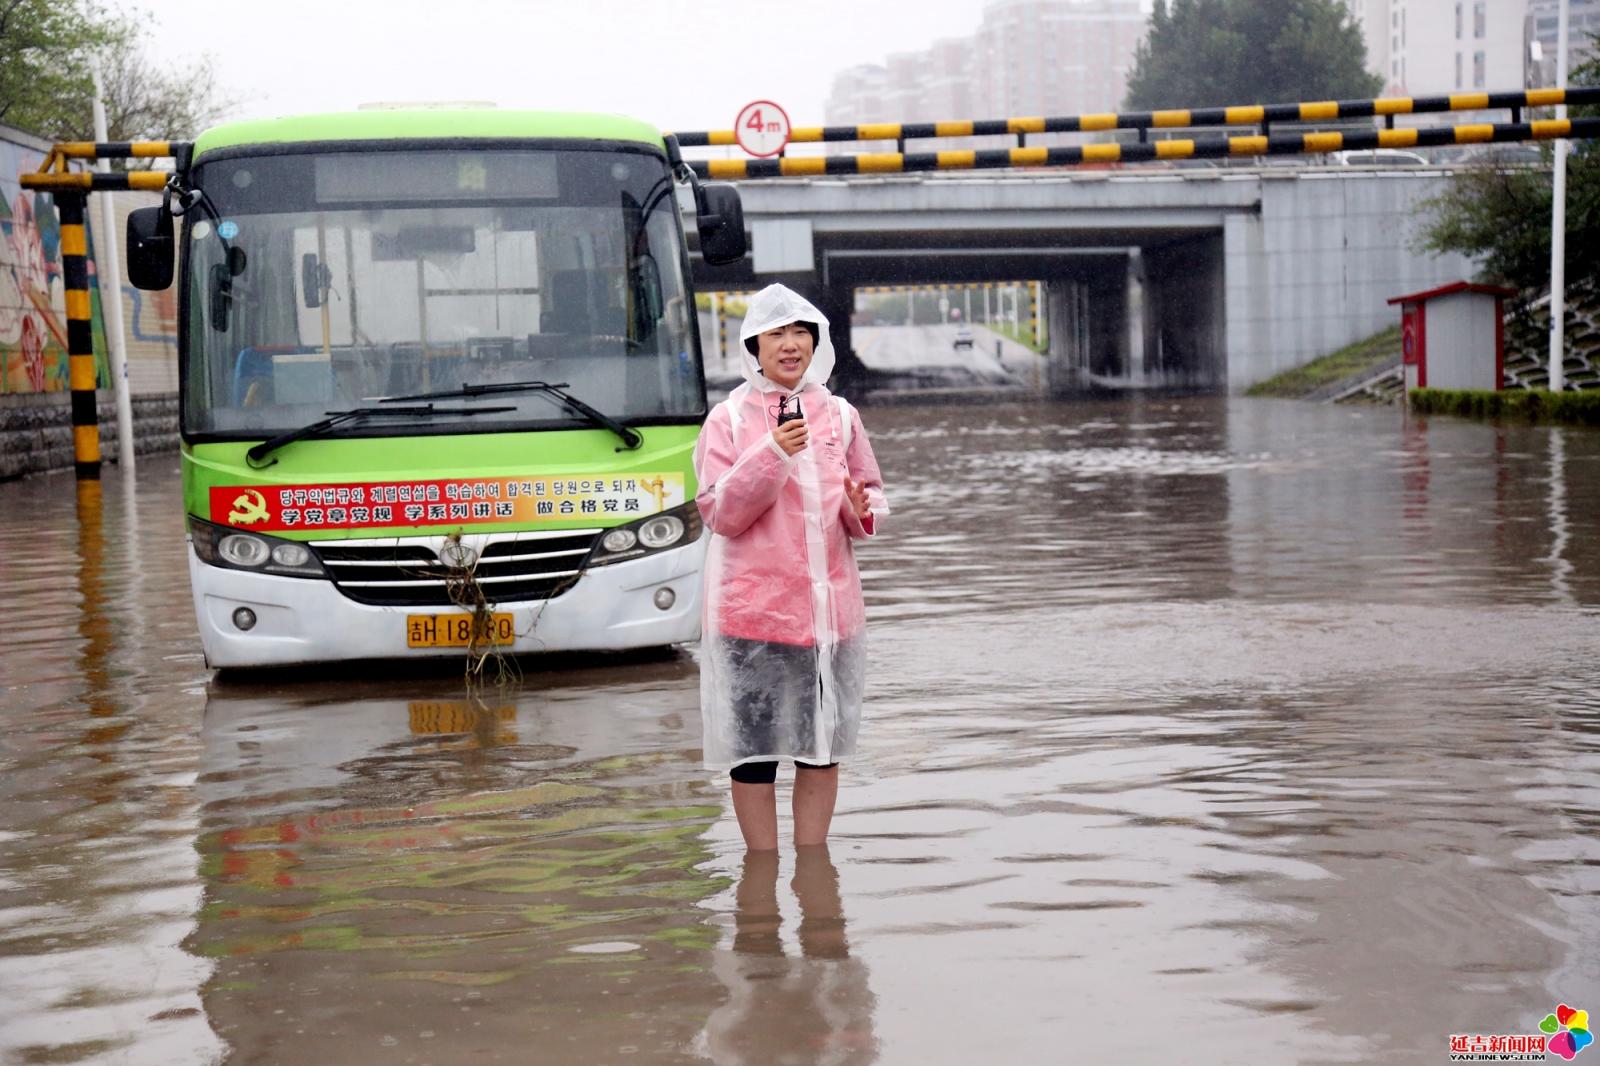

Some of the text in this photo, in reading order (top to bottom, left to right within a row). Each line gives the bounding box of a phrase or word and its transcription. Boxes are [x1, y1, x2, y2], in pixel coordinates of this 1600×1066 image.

[746, 109, 780, 133] 4m
[446, 482, 500, 499] 학습하여
[508, 482, 545, 497] 합격된
[553, 481, 605, 496] 당원으로
[612, 479, 636, 493] 되자
[283, 498, 640, 524] 学党章党规 学系列讲话 做合格党员
